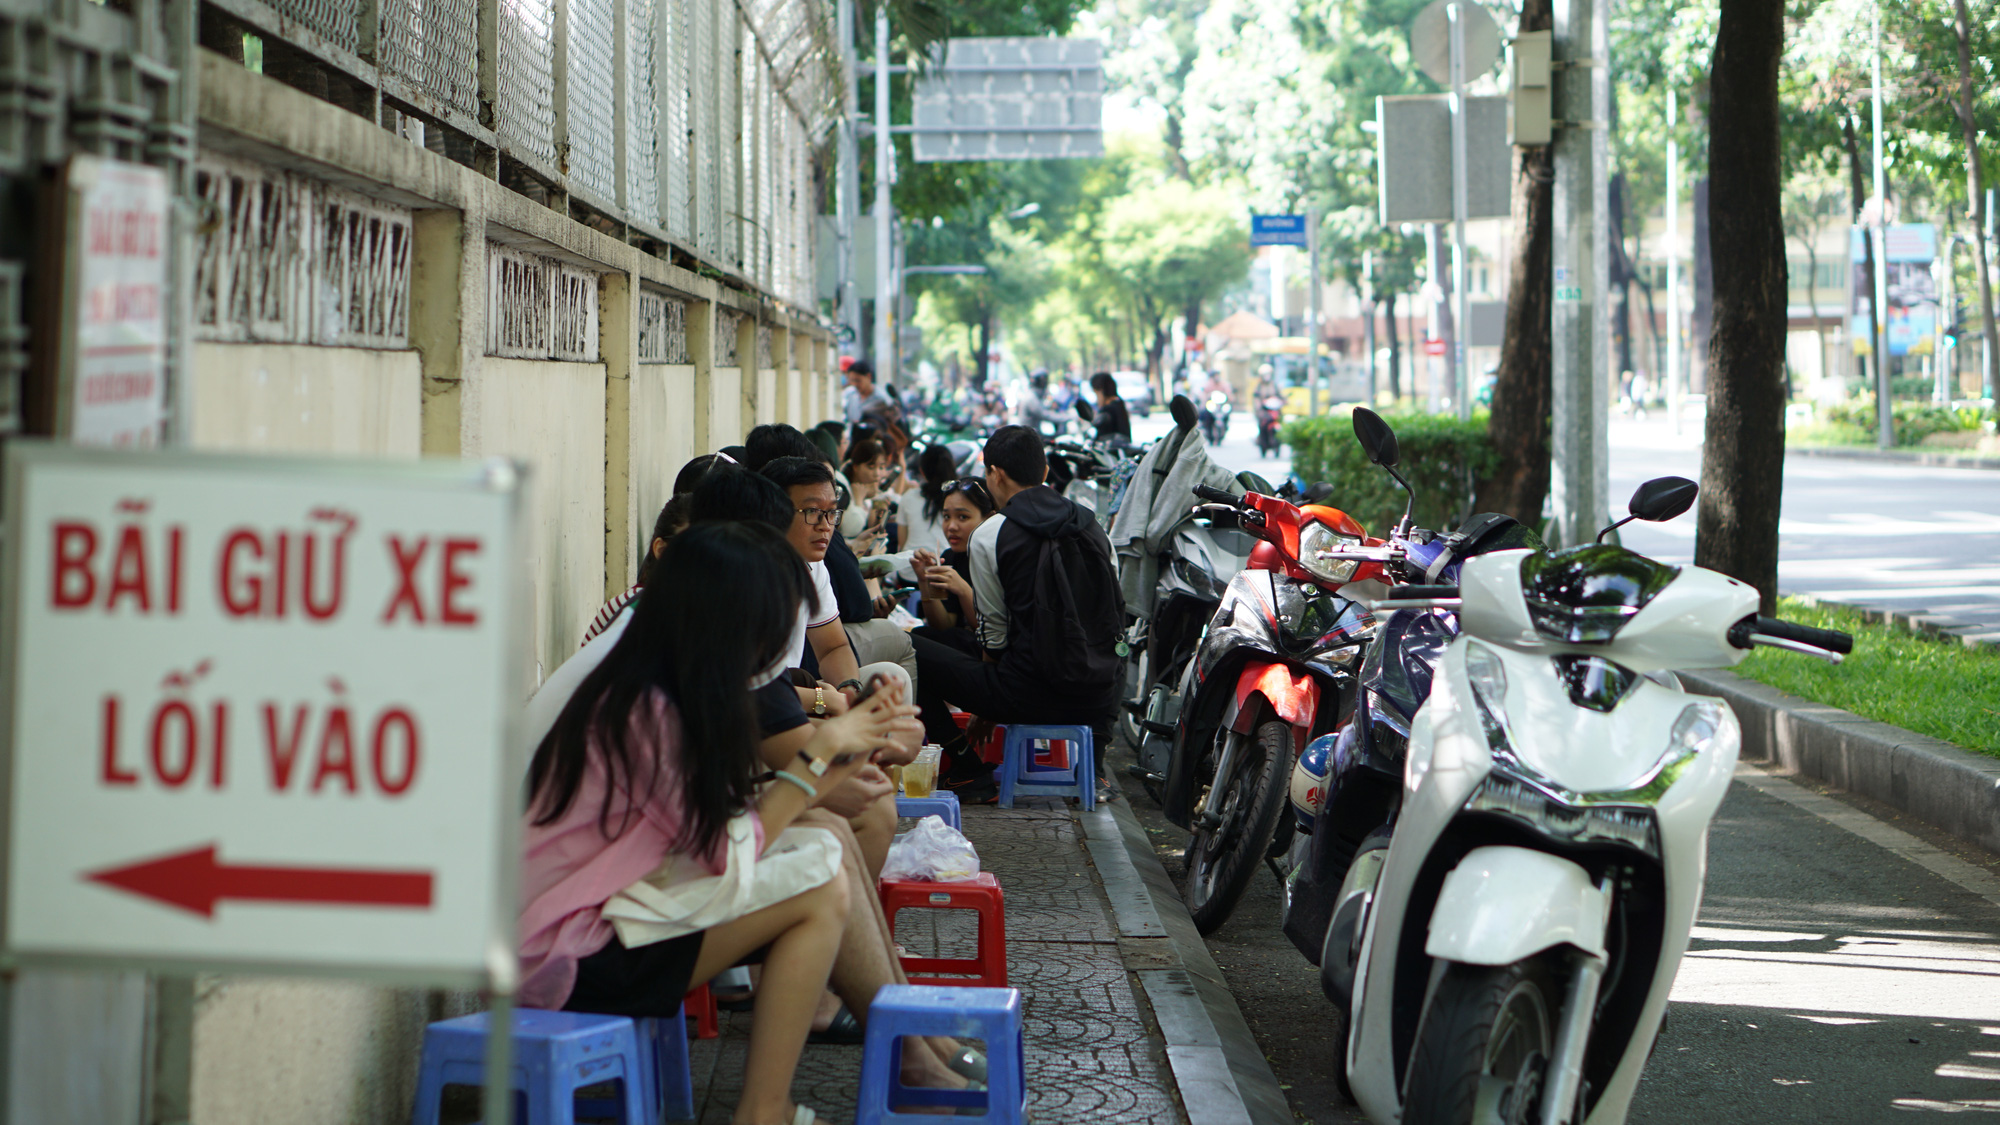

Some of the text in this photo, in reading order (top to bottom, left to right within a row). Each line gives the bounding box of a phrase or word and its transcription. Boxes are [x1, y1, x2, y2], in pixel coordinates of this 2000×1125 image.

[51, 499, 482, 626] BÃI GIỮ XE
[102, 659, 420, 799] LỐI VÀO
